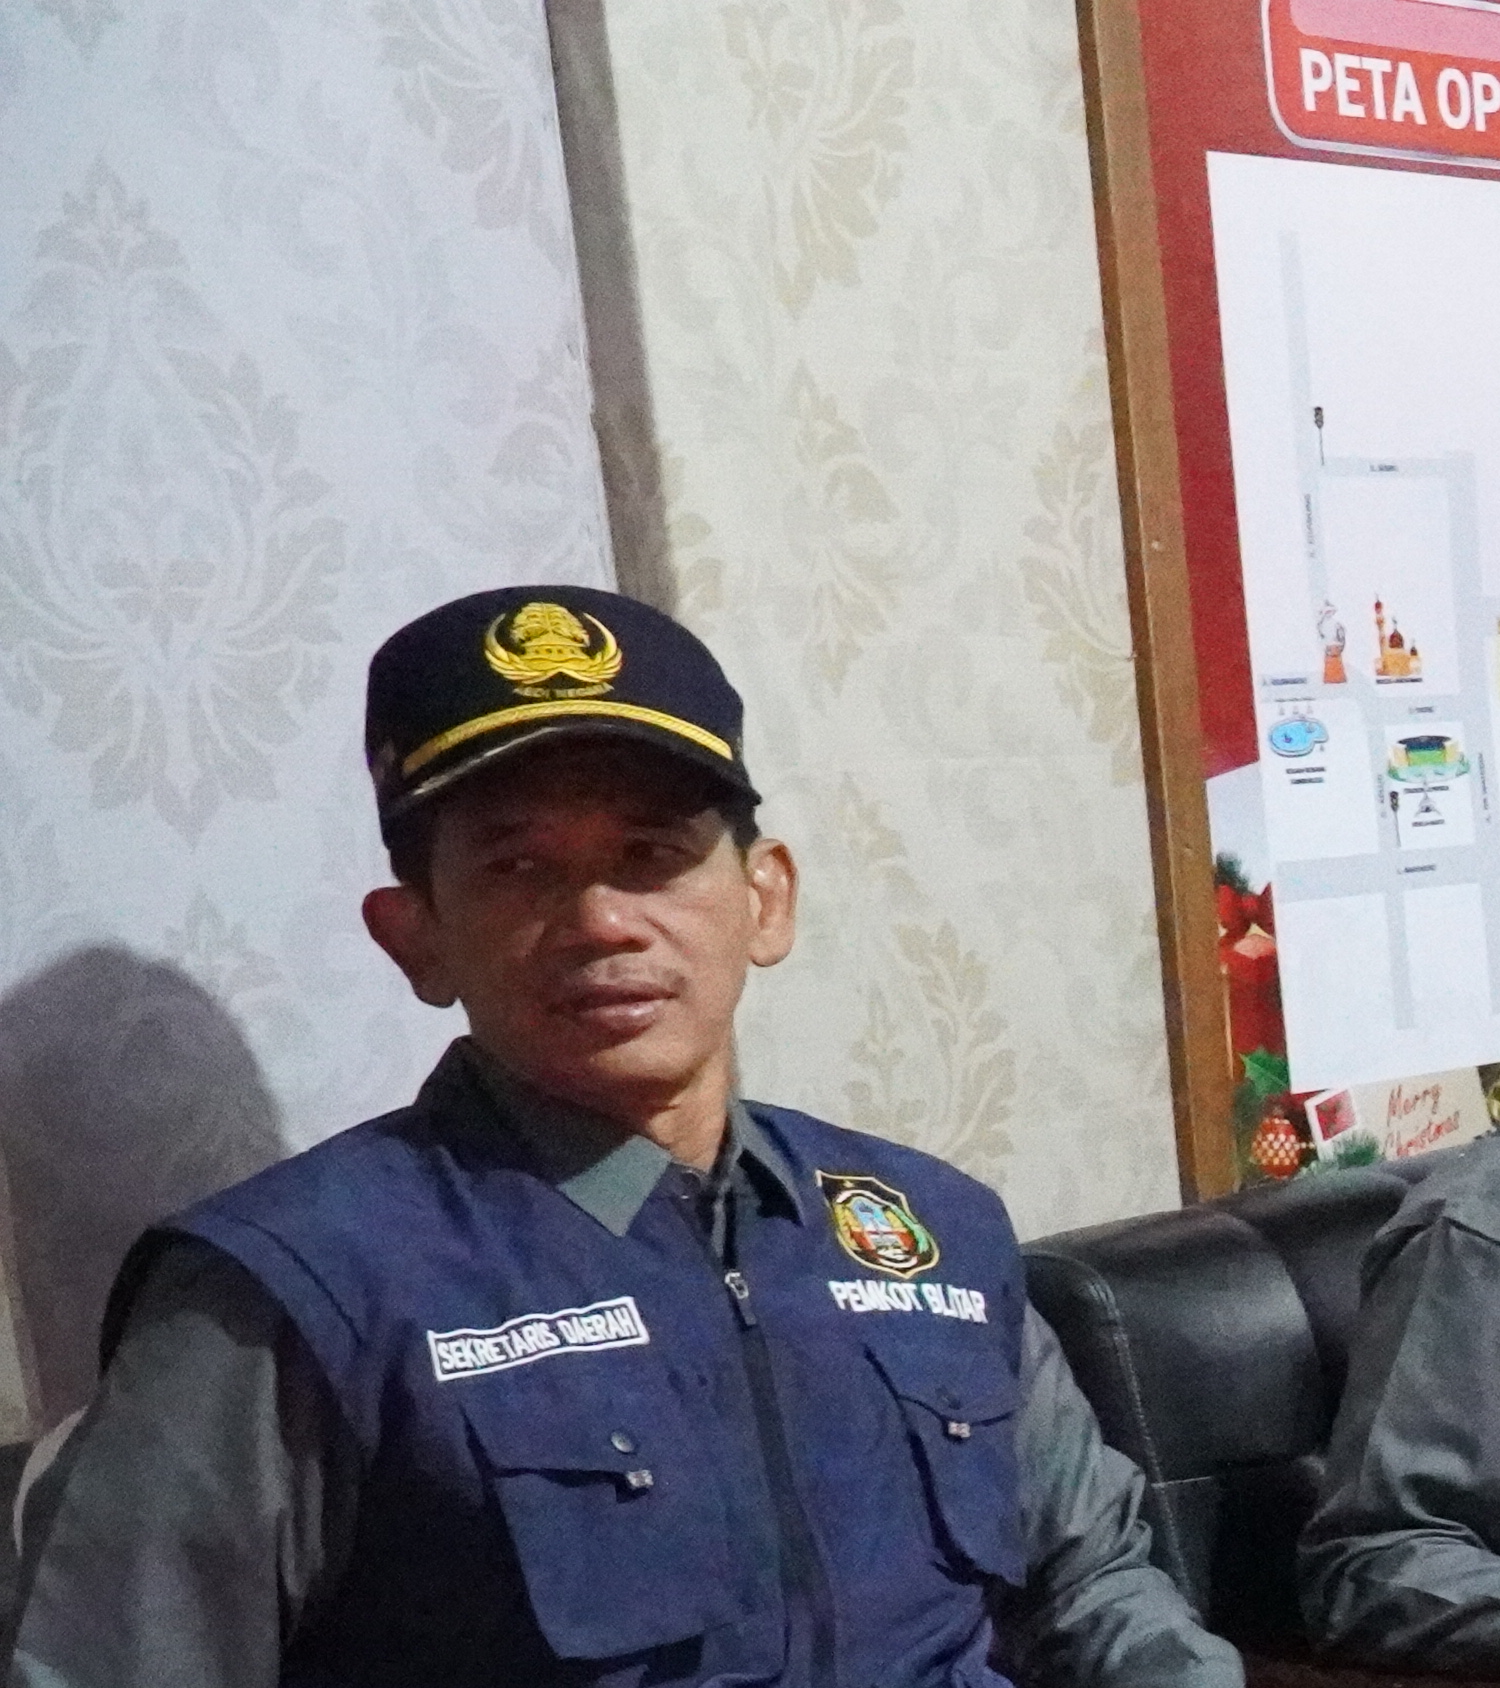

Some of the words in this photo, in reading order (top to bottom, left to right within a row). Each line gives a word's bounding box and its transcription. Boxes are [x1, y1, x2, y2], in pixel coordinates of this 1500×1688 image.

[1300, 48, 1427, 125] PETA
[828, 1279, 923, 1313] PEMKOT
[921, 1283, 988, 1324] BLITAR
[437, 1321, 561, 1372] SEKRETARIS
[557, 1307, 638, 1344] DAERAH
